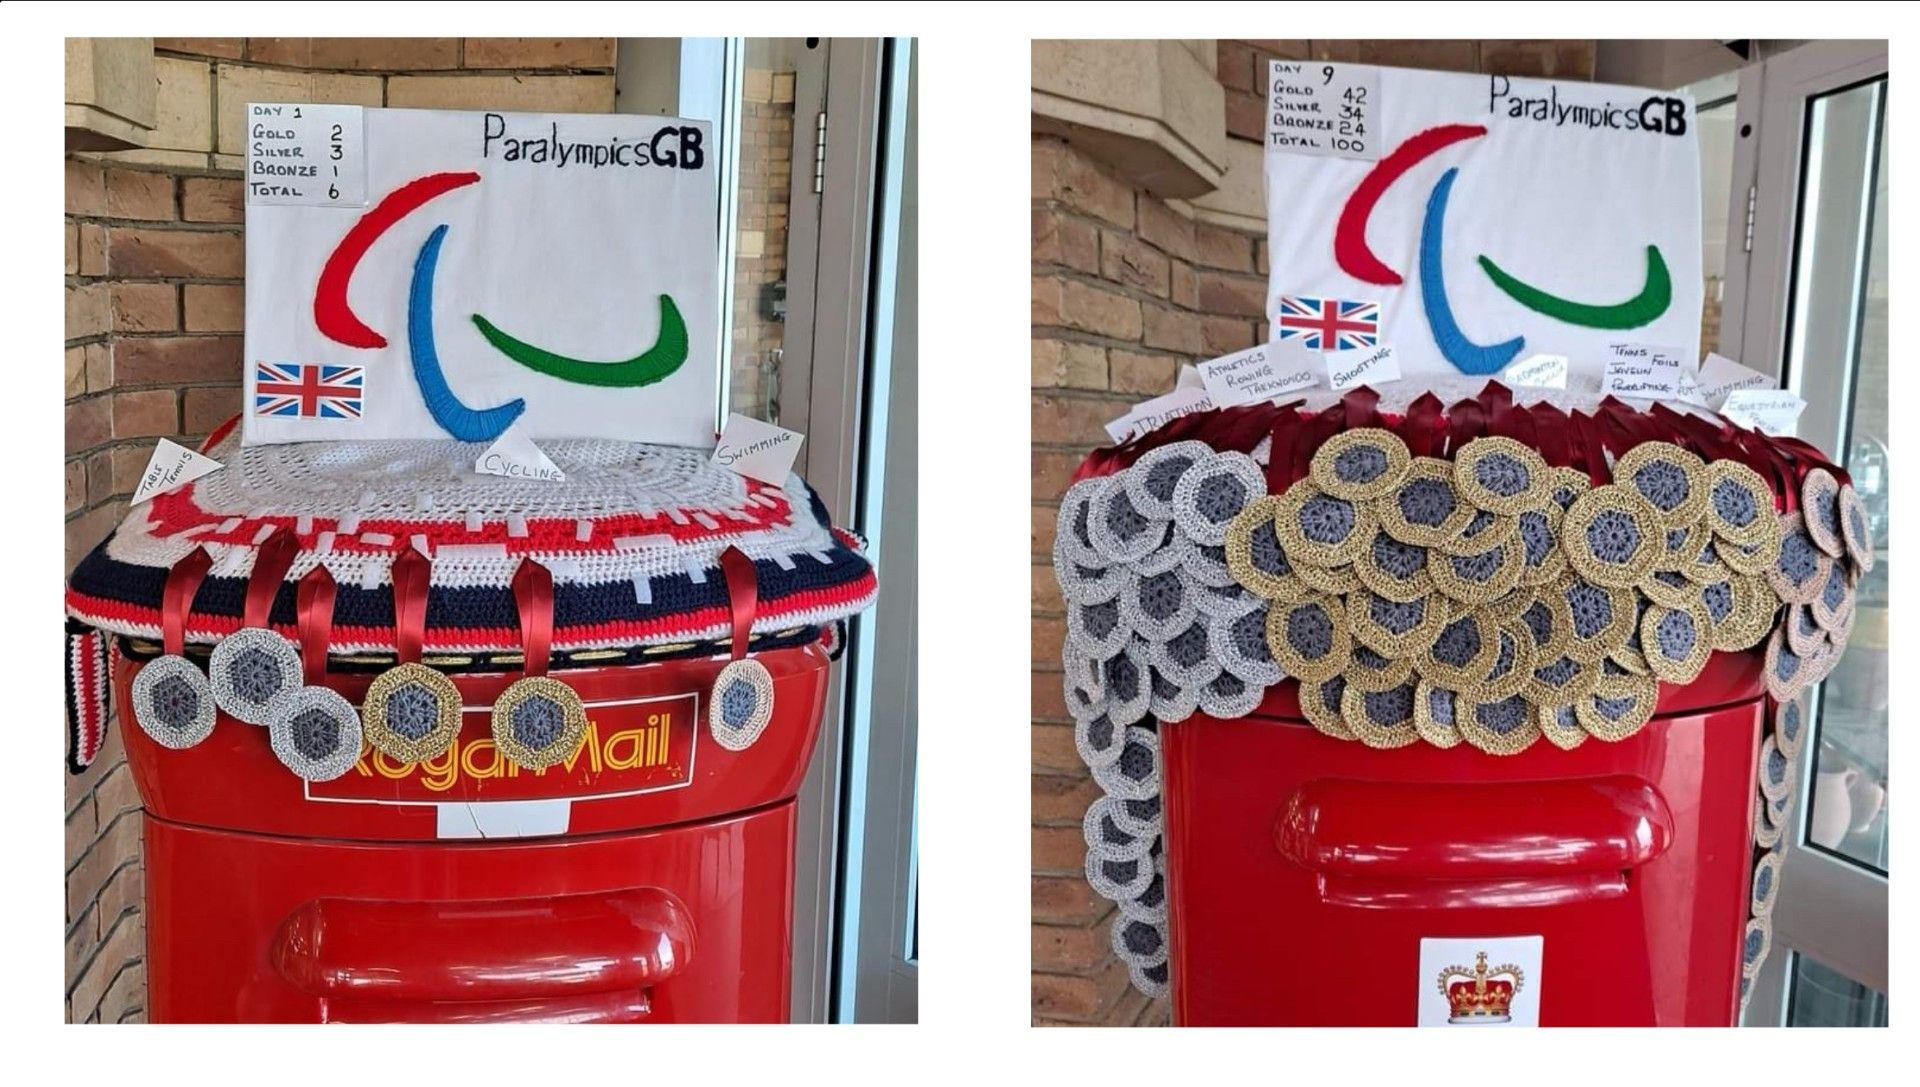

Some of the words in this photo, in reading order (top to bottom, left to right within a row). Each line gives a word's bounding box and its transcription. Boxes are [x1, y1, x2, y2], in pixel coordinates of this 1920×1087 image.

[1275, 64, 1301, 74] DAY
[1322, 66, 1334, 85] 9
[1273, 79, 1314, 96] GOLD
[1343, 87, 1367, 105] 42
[253, 106, 282, 116] DAY
[294, 107, 302, 118] 1
[1273, 96, 1321, 113] SILVER
[1338, 104, 1364, 121] 34
[1490, 75, 1687, 136] ParalympicsGB
[253, 123, 295, 139] GOLD
[331, 124, 343, 141] 2
[1273, 113, 1334, 131] BRONZE
[1339, 121, 1366, 137] 24
[253, 142, 304, 157] SILVER
[330, 144, 343, 160] 3
[484, 113, 704, 169] ParalympicsGB
[1271, 132, 1320, 147] TOTAL
[1331, 137, 1365, 152] 100
[253, 160, 318, 177] BRONZE
[333, 165, 338, 177] 1
[250, 182, 303, 196] TOTAL
[328, 183, 340, 199] 6
[1208, 352, 1266, 378] ATHLETICS
[1333, 347, 1391, 387] SHOOTING
[1652, 354, 1679, 367] FOILS
[717, 432, 791, 465] SWIMMING
[140, 463, 162, 495] TABLE
[158, 452, 193, 488] TENNIS
[484, 453, 562, 482] CYCLING
